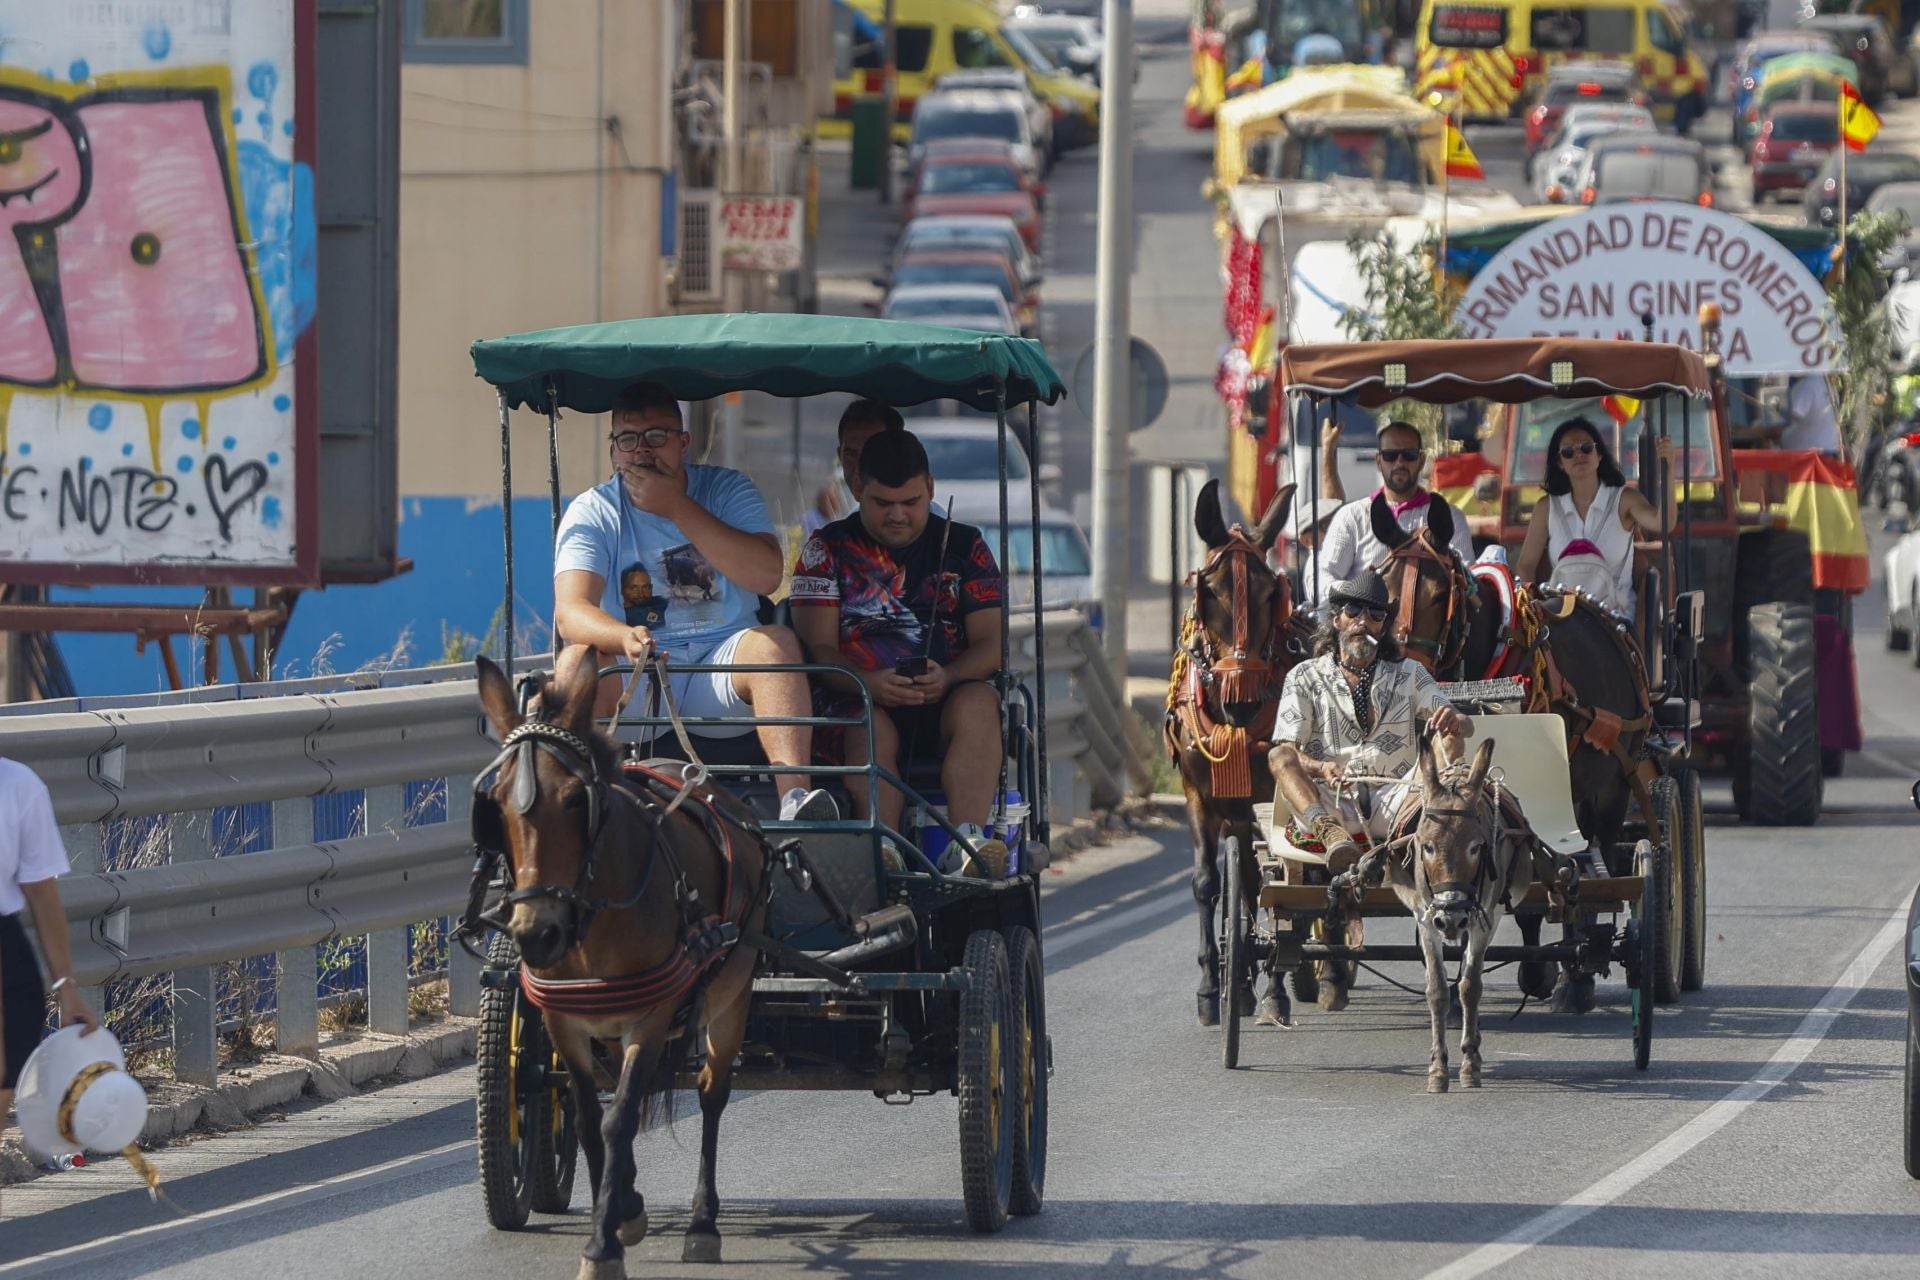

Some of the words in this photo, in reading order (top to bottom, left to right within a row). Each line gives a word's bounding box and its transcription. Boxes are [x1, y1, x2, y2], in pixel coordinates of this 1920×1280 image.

[722, 199, 795, 218] KEBAB
[727, 219, 790, 240] PIZZA
[1538, 282, 1615, 320] SAN
[1642, 212, 1693, 253] DE
[1694, 222, 1837, 368] ROMEROS
